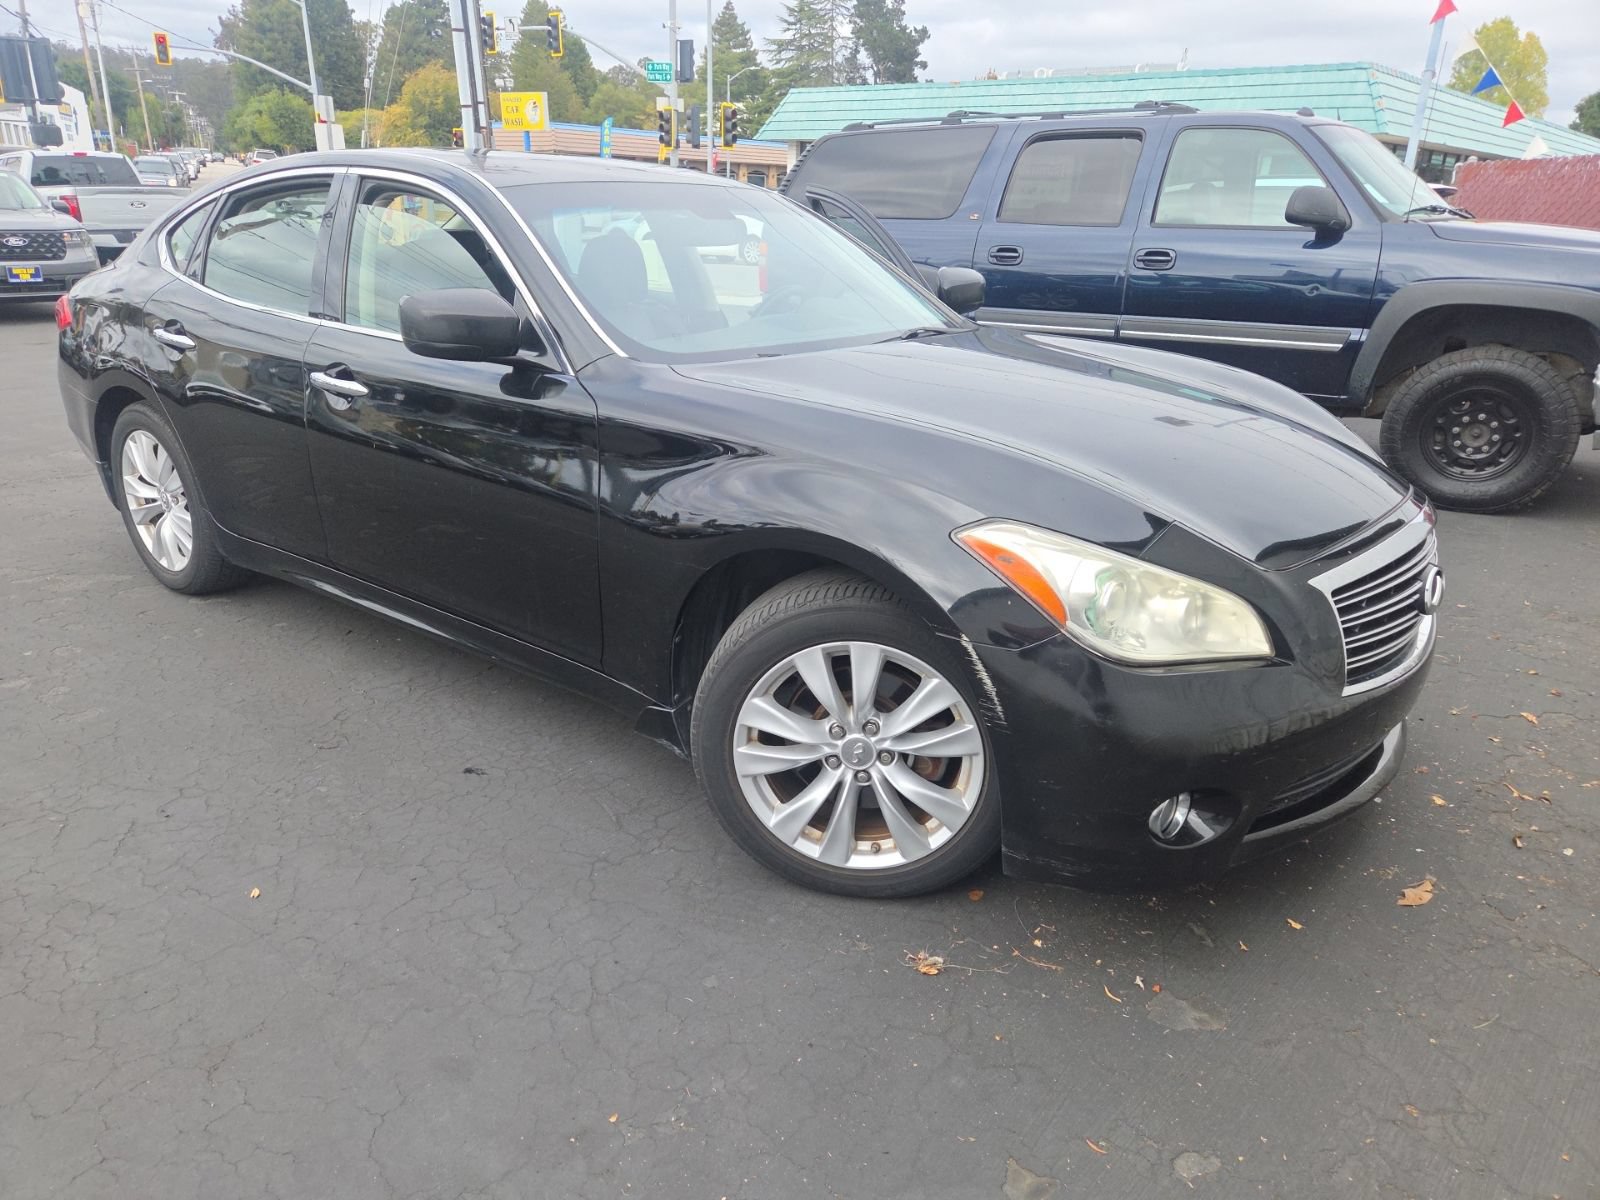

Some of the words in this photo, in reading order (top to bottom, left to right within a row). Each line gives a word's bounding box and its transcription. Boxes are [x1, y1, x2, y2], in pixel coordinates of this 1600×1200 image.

[662, 63, 670, 71] Way
[505, 105, 519, 114] CAR
[503, 117, 524, 126] WASH
